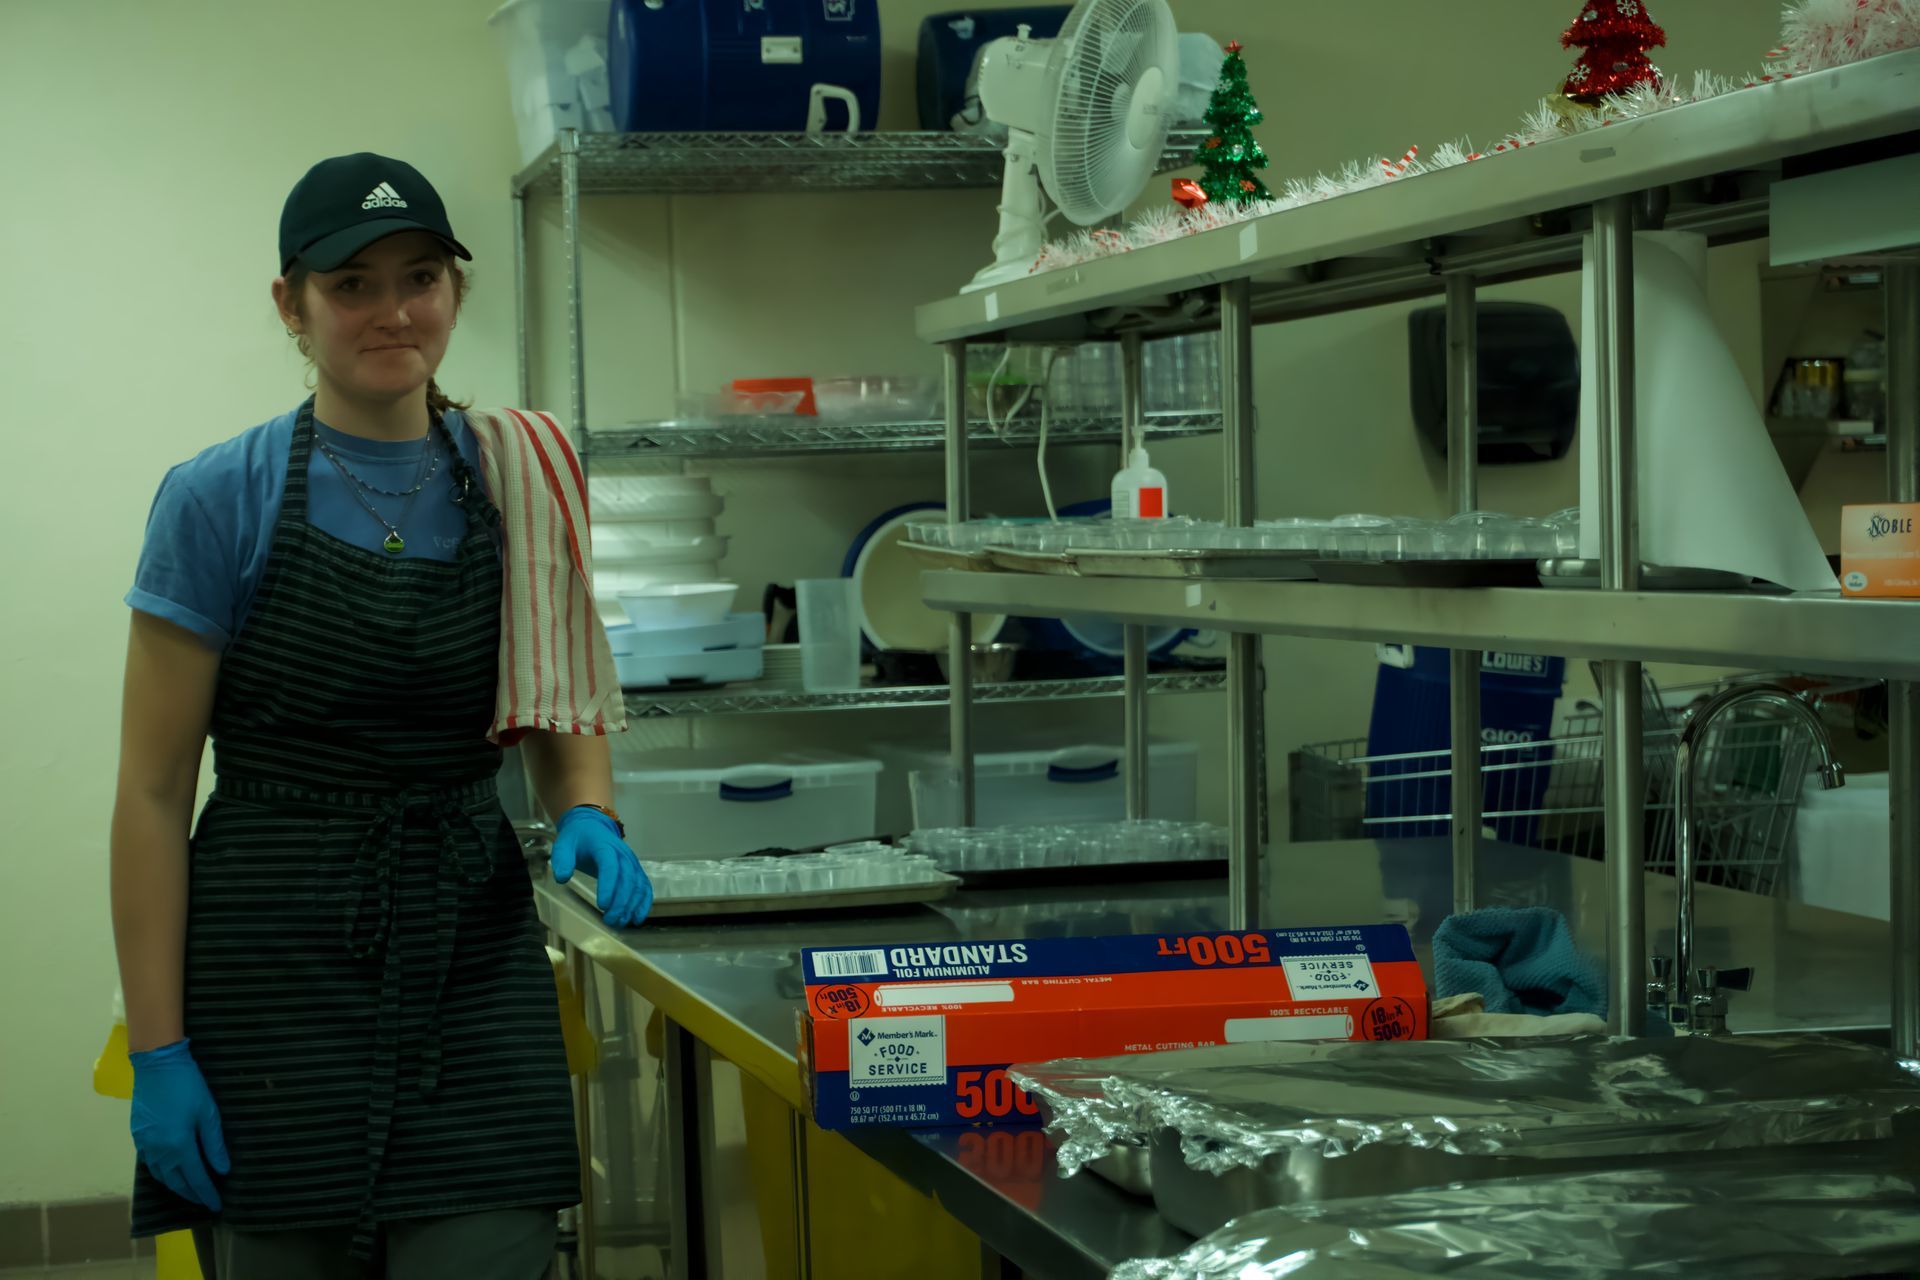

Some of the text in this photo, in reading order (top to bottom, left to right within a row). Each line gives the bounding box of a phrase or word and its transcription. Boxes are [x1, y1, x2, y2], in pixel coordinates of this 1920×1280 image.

[361, 197, 408, 210] adidas
[1868, 515, 1912, 537] NOBLE
[890, 943, 1028, 967] STANDARD
[892, 965, 990, 978] ALUMINUM FOIL
[1300, 961, 1353, 970] SERVICE
[1315, 973, 1347, 981] FOOD
[1270, 1006, 1349, 1016] 100% RECYCLABLE
[877, 1031, 913, 1039] Member's
[879, 1044, 915, 1058] FOOD
[1124, 1043, 1152, 1052] METAL
[1156, 1040, 1194, 1050] CUTTING
[868, 1063, 927, 1075] SERVICE
[850, 1106, 861, 1114] 750
[862, 1106, 870, 1114] SQ
[880, 1105, 894, 1114] (500
[908, 1104, 915, 1112] 18
[916, 1104, 926, 1112] IN)
[878, 1114, 897, 1123] (152.4
[927, 1112, 939, 1120] cm)
